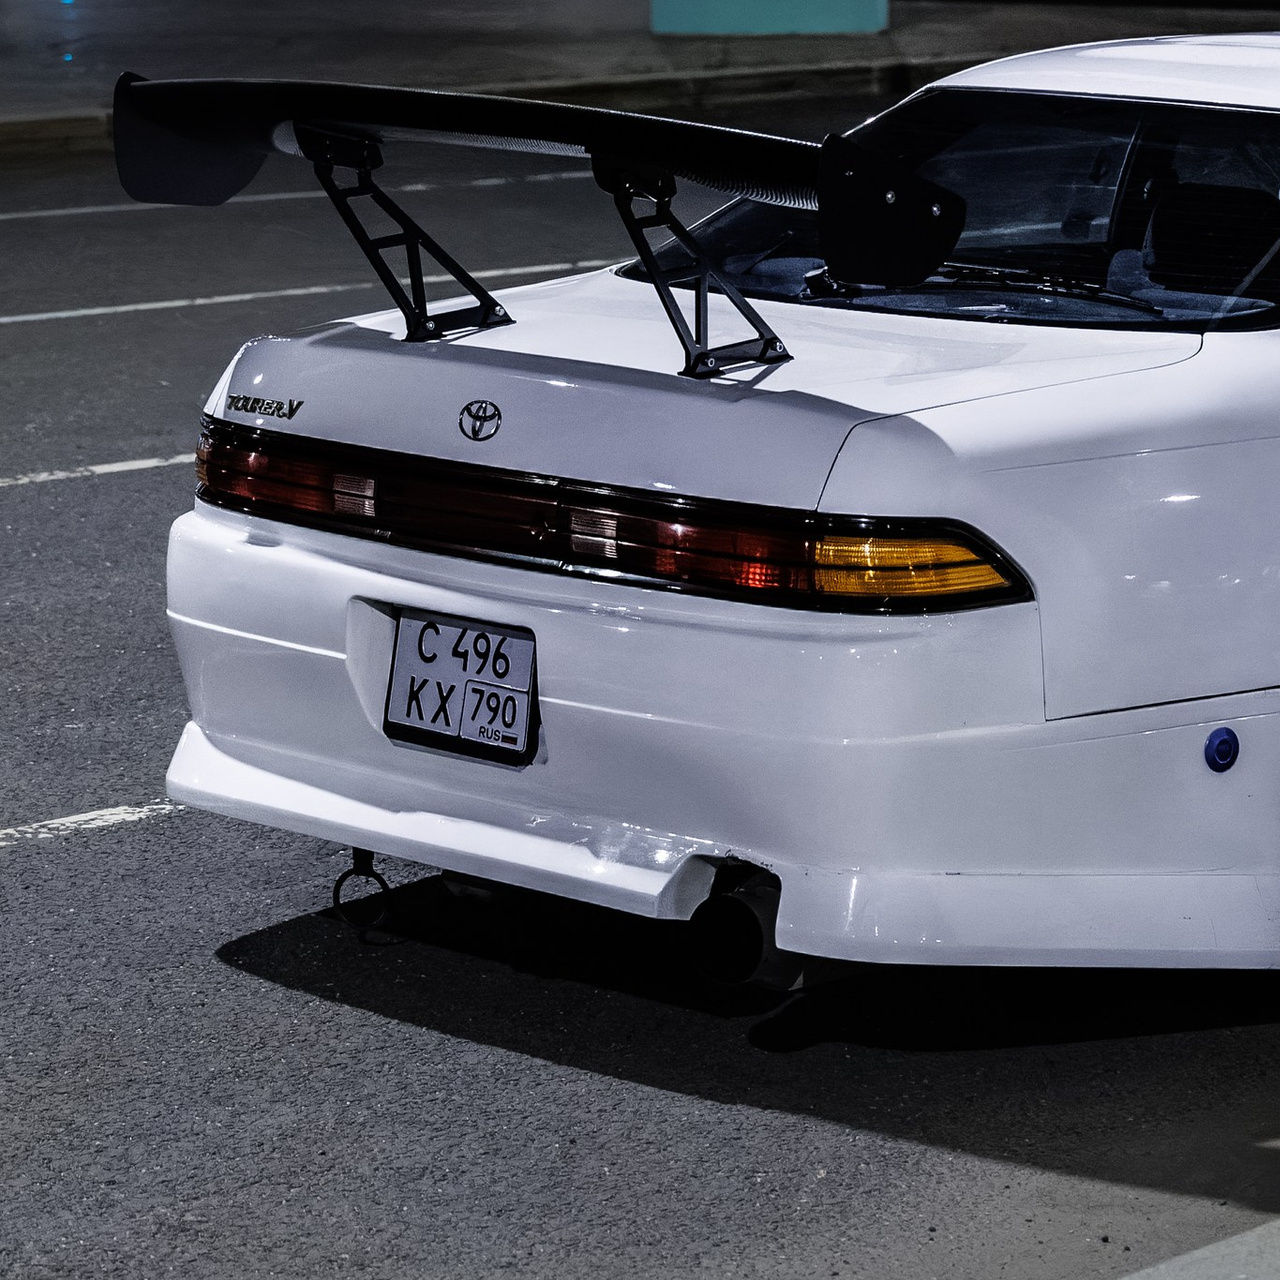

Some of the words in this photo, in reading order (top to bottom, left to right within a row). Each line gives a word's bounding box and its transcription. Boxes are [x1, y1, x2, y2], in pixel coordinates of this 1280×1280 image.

[452, 627, 511, 679] 496
[471, 687, 517, 729] 790
[478, 726, 501, 742] RUS
